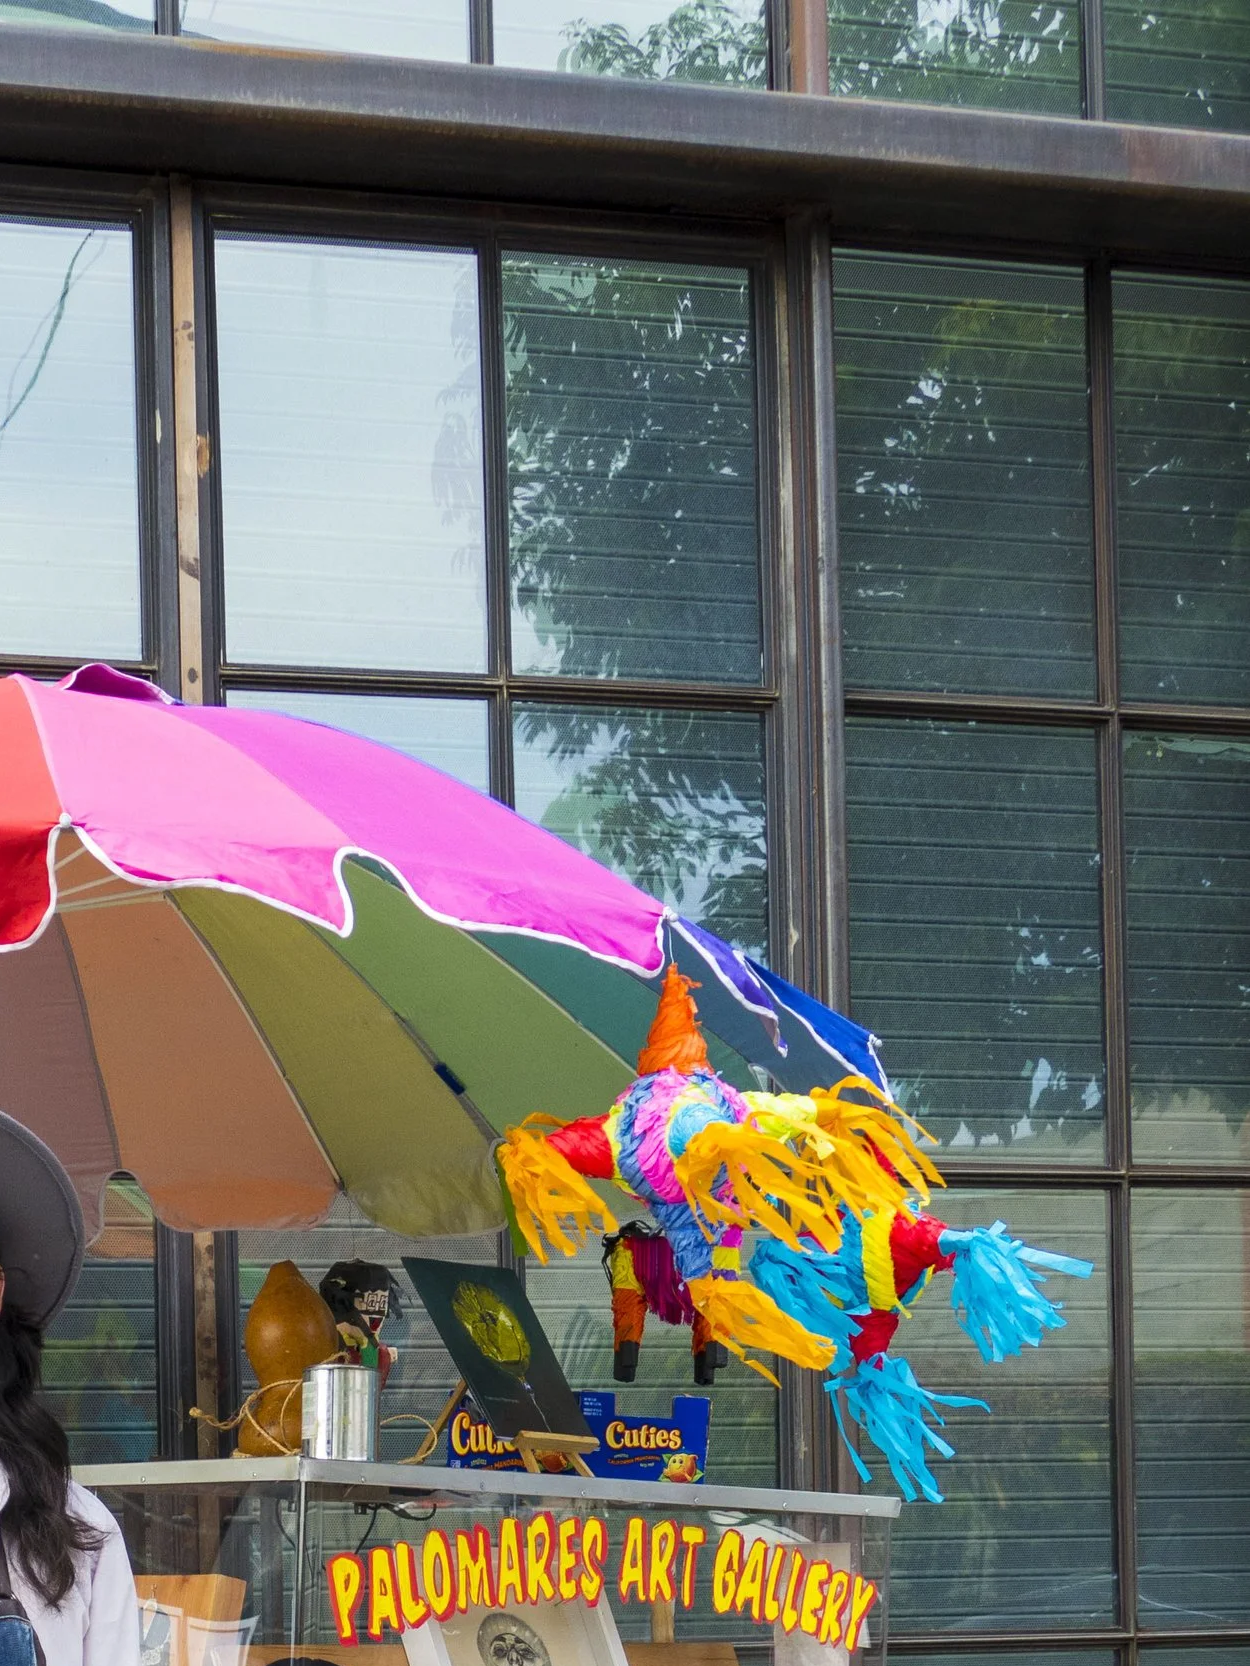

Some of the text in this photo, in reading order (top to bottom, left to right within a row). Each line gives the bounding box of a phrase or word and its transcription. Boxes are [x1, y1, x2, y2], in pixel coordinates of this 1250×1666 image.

[452, 1411, 517, 1455] Cut
[605, 1420, 682, 1450] Cuties
[327, 1511, 878, 1653] PALOMARES ART GALLERY
